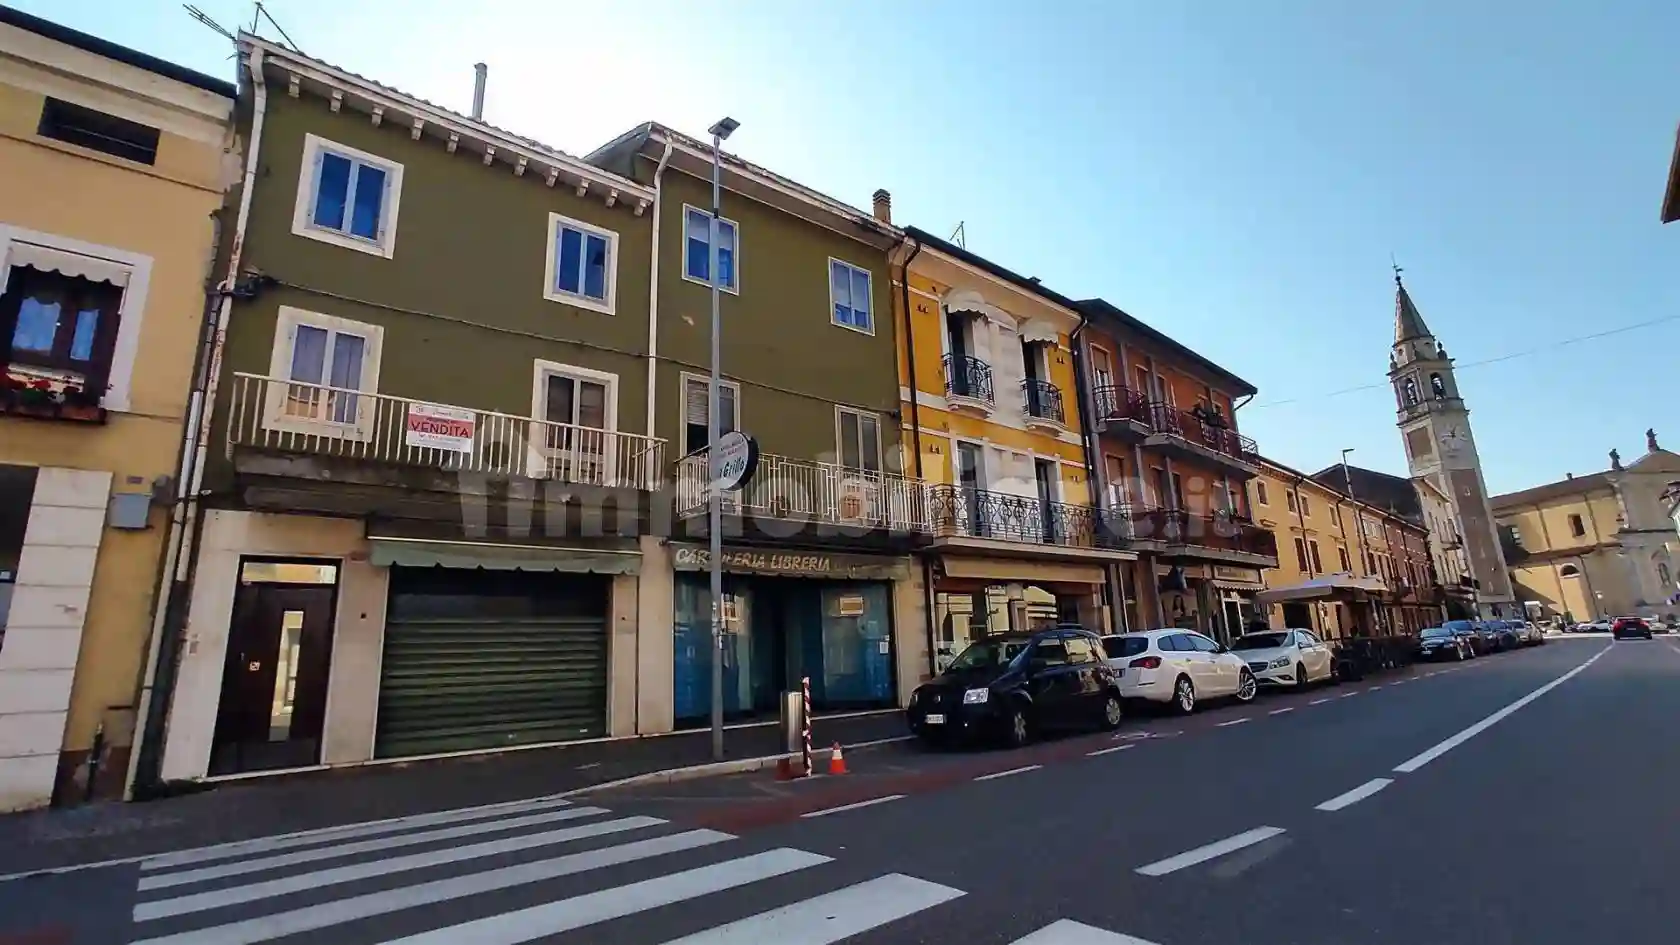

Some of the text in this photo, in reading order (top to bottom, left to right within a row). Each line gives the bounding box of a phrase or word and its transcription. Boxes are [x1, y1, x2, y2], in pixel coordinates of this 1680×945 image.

[410, 421, 469, 438] VENDITA
[675, 548, 830, 571] CARLERIA LIBRERIA
